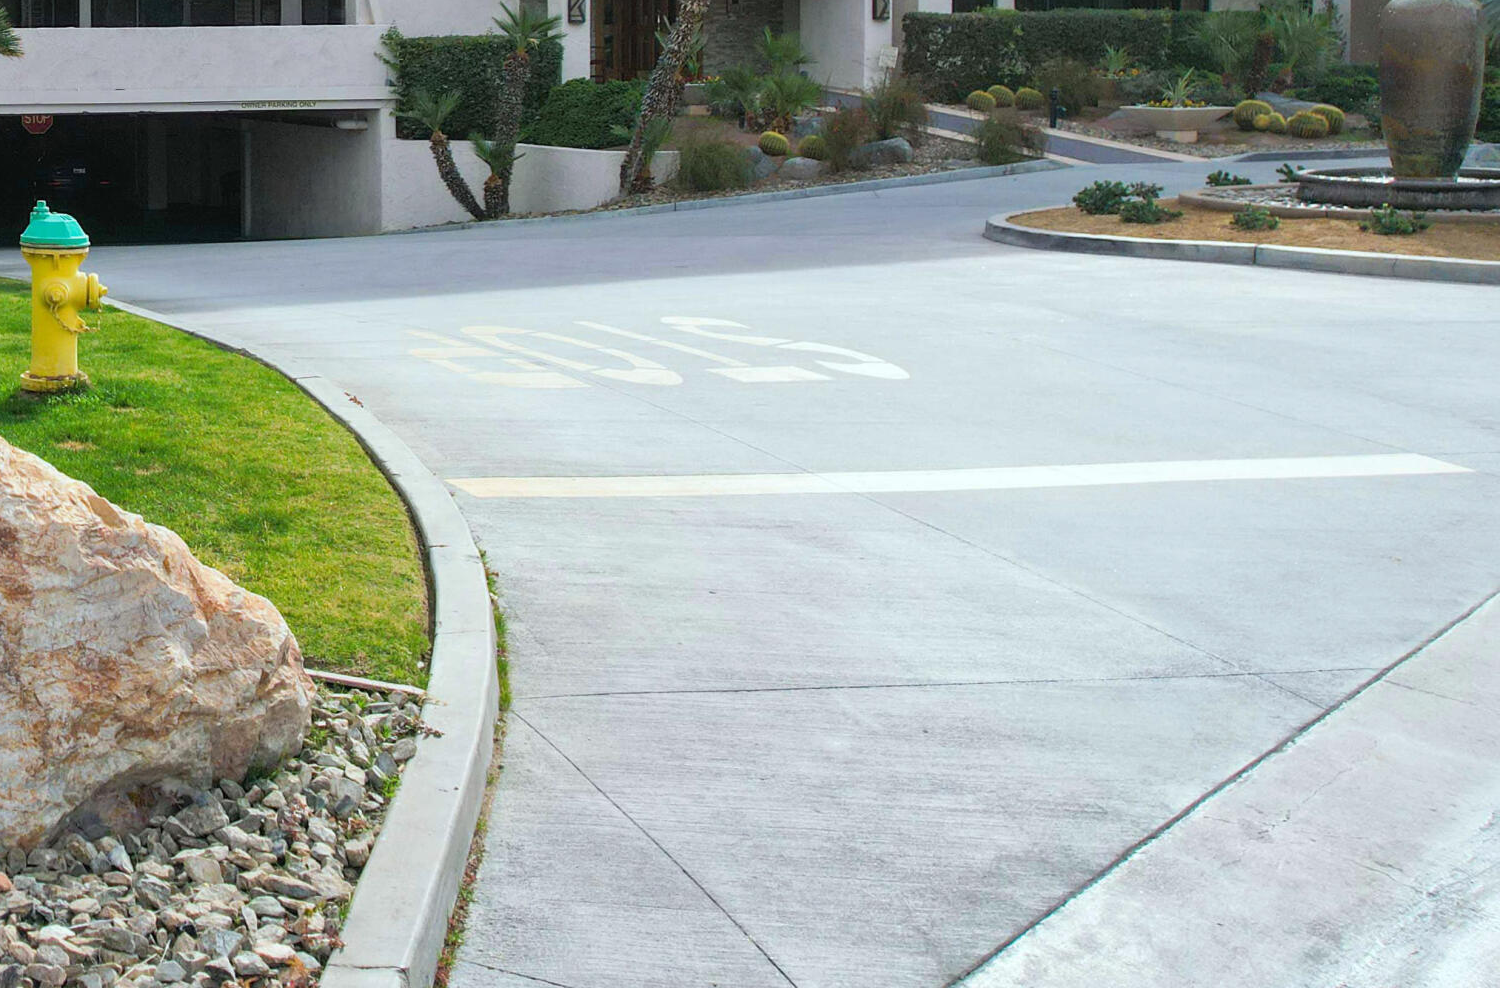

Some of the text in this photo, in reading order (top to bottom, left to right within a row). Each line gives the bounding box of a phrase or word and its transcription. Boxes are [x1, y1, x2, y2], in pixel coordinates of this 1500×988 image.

[268, 100, 298, 108] PARKING
[299, 99, 317, 108] ONLY
[24, 114, 50, 124] STOP
[406, 316, 910, 389] STOP
